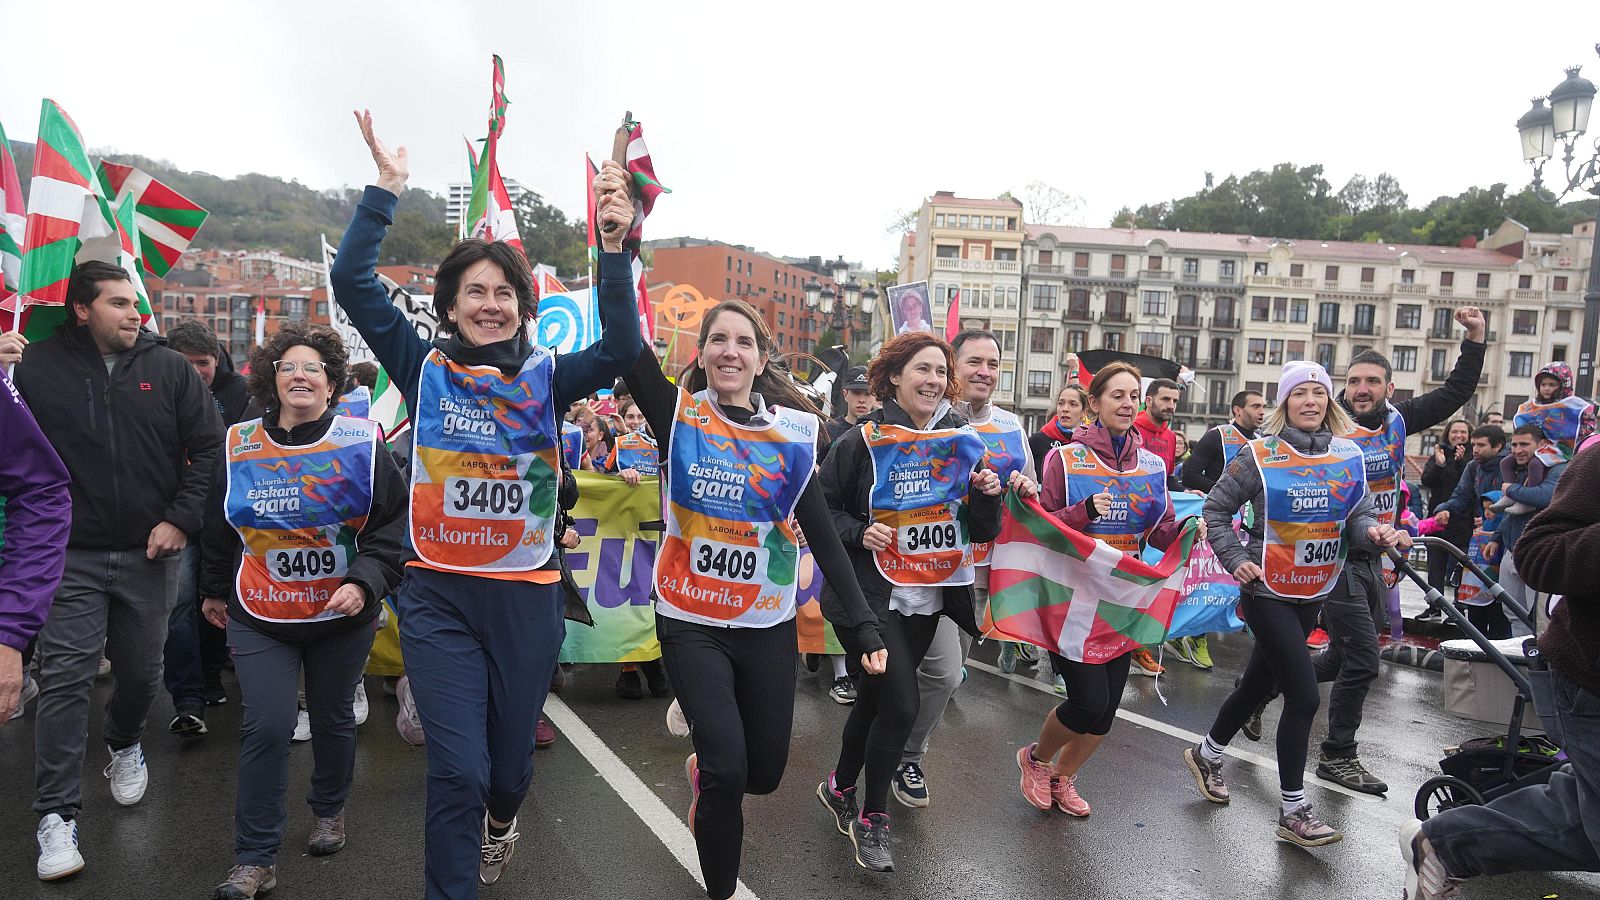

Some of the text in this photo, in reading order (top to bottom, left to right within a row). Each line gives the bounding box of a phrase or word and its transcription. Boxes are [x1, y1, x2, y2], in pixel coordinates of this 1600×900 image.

[440, 397, 490, 419] Euskar
[345, 428, 369, 437] eitb
[443, 413, 497, 436] gara
[791, 422, 812, 437] eitb
[461, 460, 499, 470] LABORAL
[1366, 453, 1389, 463] skara
[688, 463, 746, 485] Euskara
[889, 469, 930, 482] Euskara
[246, 486, 300, 500] Euskara
[454, 480, 524, 514] 3409
[691, 479, 745, 501] gara
[894, 479, 931, 499] gara
[1287, 487, 1328, 497] Euskara
[252, 497, 300, 516] gara
[1292, 496, 1329, 512] gara
[1374, 492, 1396, 512] 40
[419, 523, 509, 546] 24.korrika
[709, 525, 743, 536] LABORAL
[907, 524, 957, 551] 3409
[697, 544, 757, 580] 3409
[1304, 540, 1339, 564] 3409
[276, 550, 336, 578] 3409
[882, 556, 952, 572] 24.korrika
[246, 584, 330, 603] 24.korrika
[660, 575, 784, 611] 24.korrika aek
